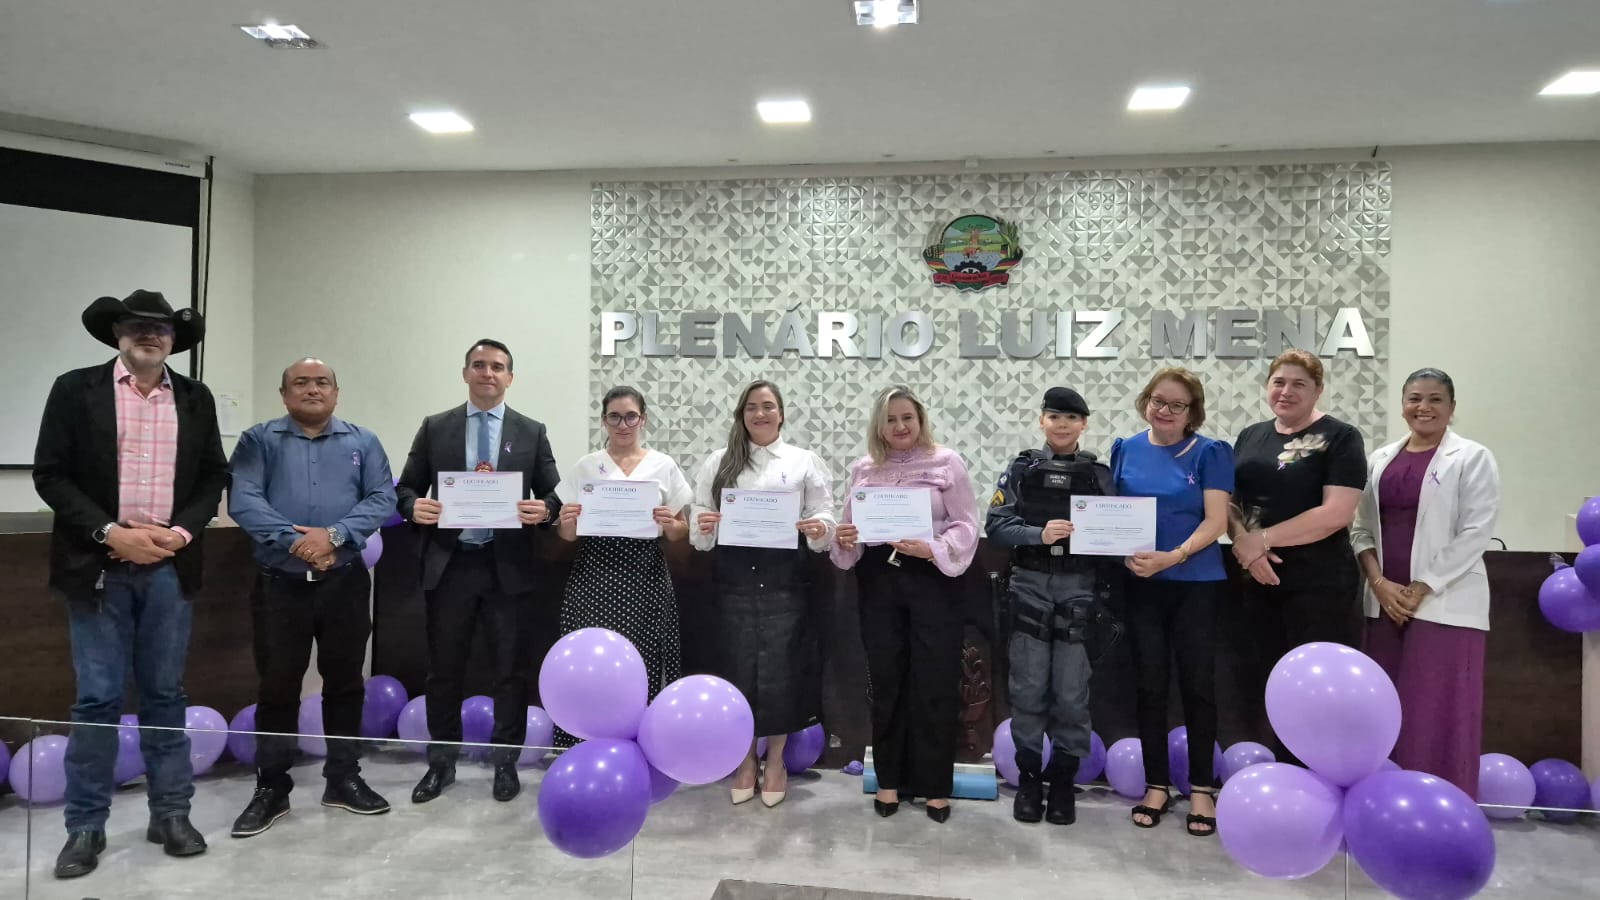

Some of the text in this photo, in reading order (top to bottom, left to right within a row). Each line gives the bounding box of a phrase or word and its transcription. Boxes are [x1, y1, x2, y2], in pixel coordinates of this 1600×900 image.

[600, 300, 1376, 359] PLENÁRIO LUIZ MENA
